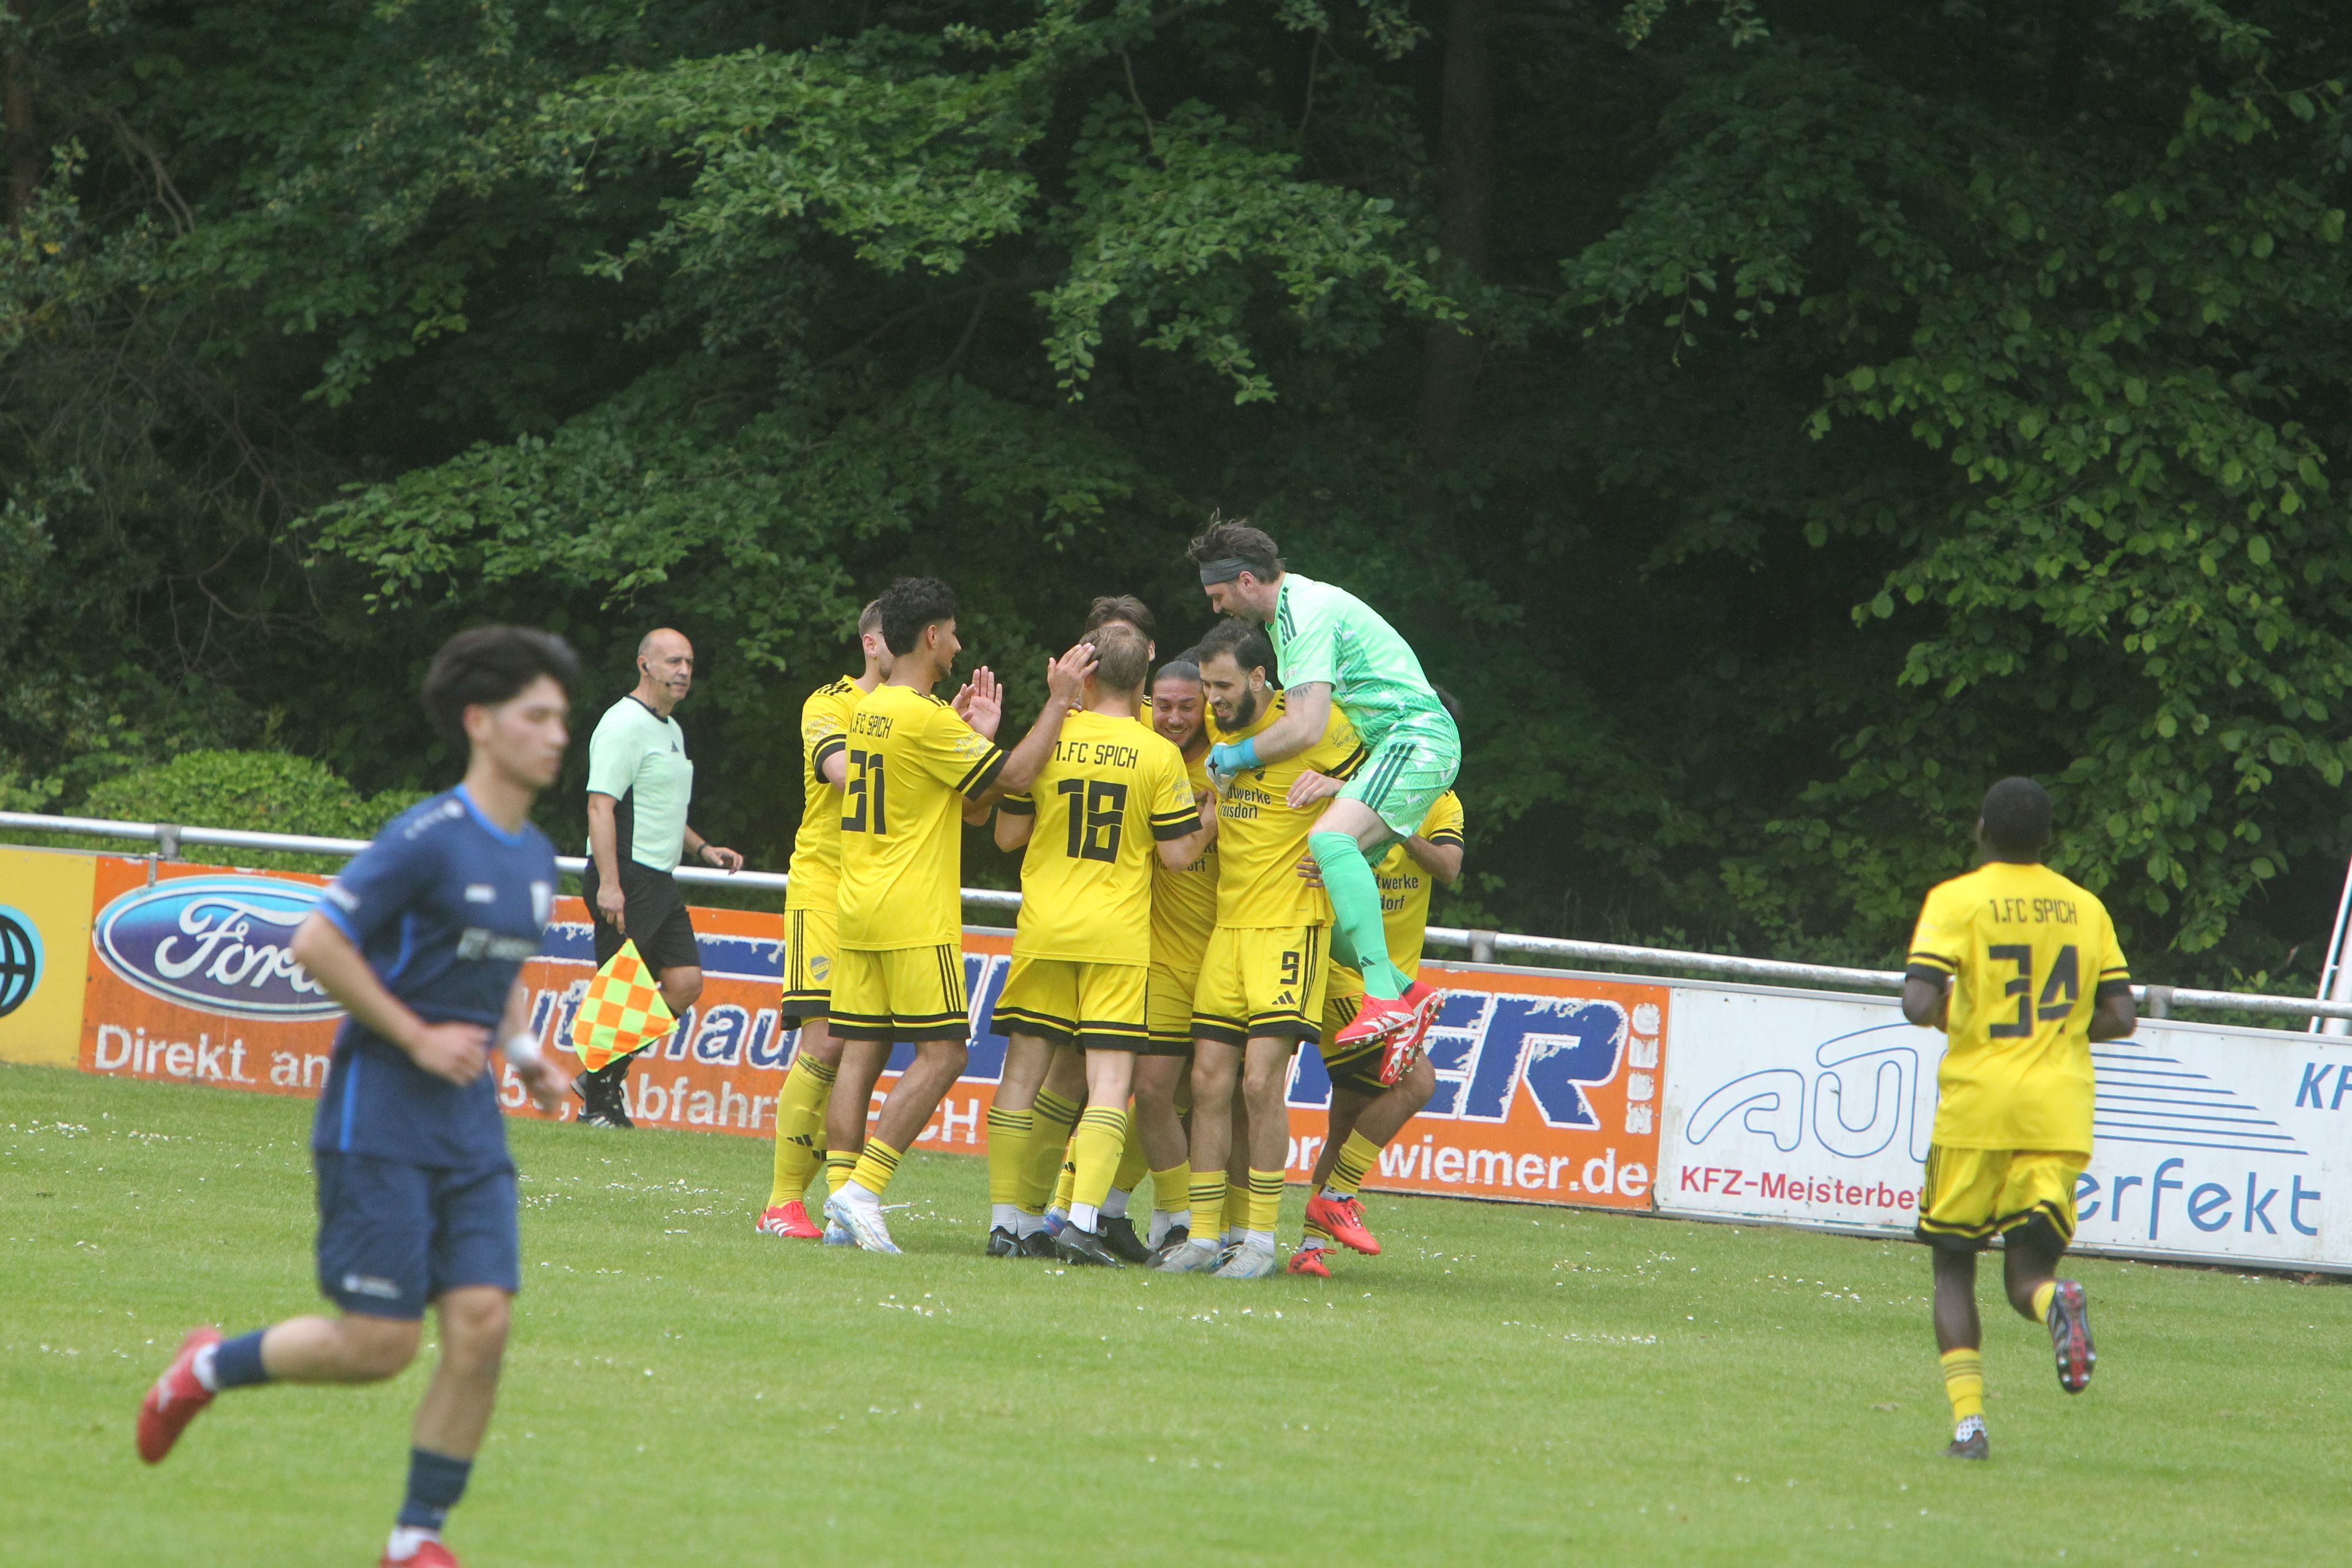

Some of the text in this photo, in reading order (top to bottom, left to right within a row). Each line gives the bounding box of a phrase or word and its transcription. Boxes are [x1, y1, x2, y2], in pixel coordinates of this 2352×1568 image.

[867, 715, 893, 739] SPICH
[1055, 741, 1138, 770] 1.FC SPICH
[841, 750, 886, 835] 31
[1228, 784, 1271, 805] dtwerke
[1058, 778, 1128, 864] 18
[1375, 873, 1419, 890] twerke
[1990, 898, 2078, 925] 1.FC SPICH
[1989, 944, 2080, 1039] 34
[95, 1024, 330, 1088] Direkt an
[1686, 1022, 1949, 1164] AUT
[1680, 1165, 1925, 1211] KFZ-Meisterbe
[2076, 1157, 2321, 1241] erfekt
